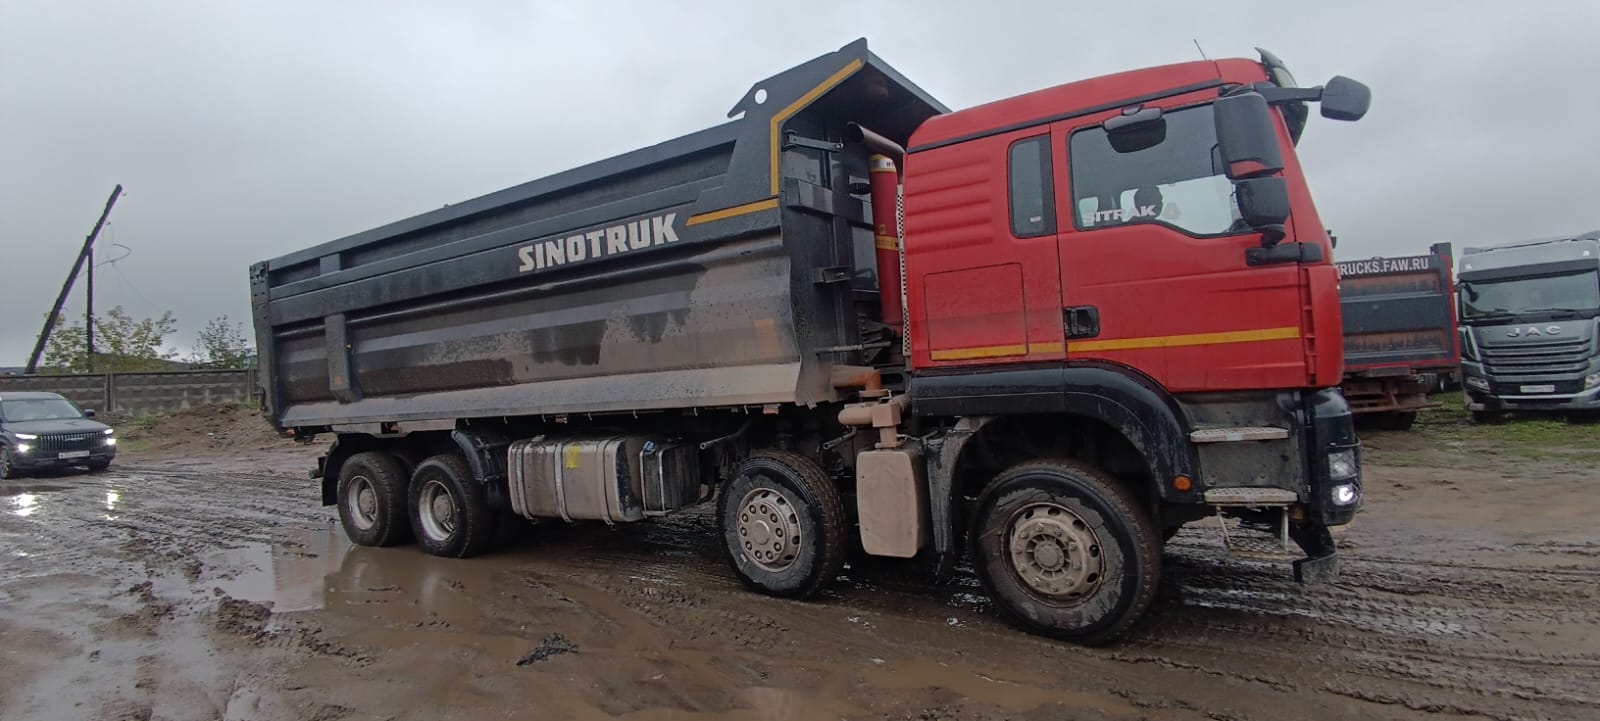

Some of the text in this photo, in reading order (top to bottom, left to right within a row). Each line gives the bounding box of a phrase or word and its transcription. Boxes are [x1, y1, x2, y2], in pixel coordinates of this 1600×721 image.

[1081, 204, 1156, 222] SITRAK
[518, 212, 679, 272] SINOTRUK
[1506, 325, 1561, 337] JAC
